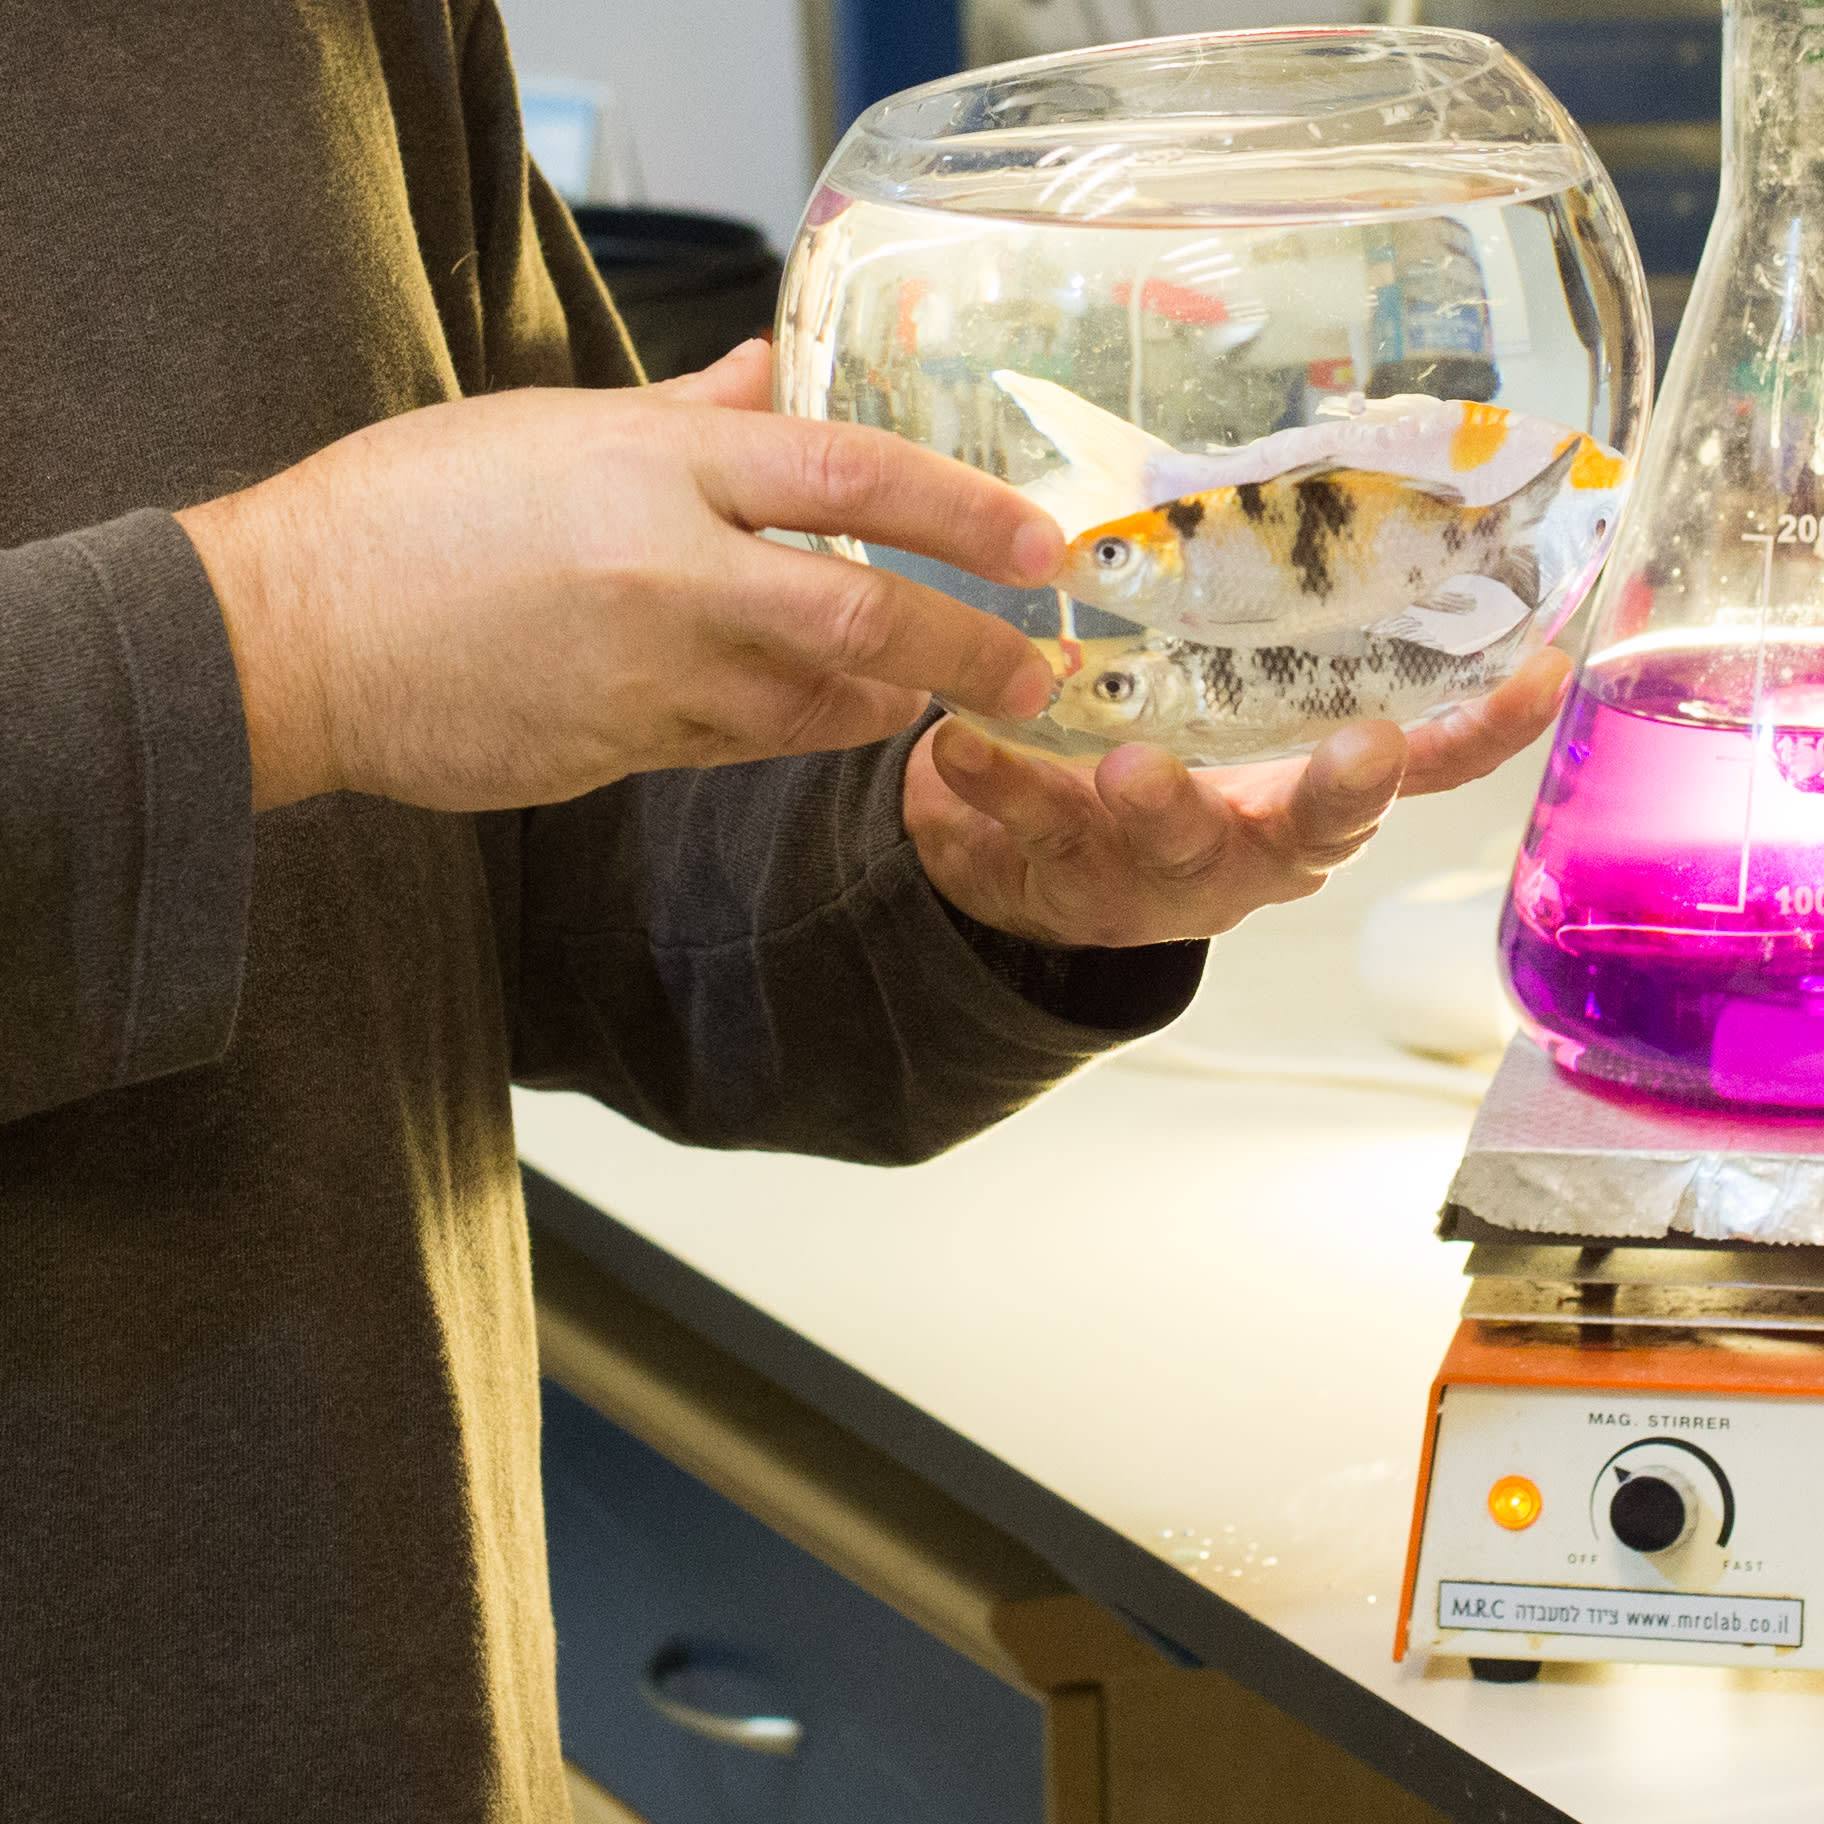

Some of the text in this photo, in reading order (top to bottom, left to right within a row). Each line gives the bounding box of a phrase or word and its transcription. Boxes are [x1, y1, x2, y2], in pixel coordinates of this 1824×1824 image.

[1588, 1412, 1732, 1431] MAG. STIRRER
[1567, 1552, 1600, 1567] OFF
[1722, 1559, 1765, 1574] FAST
[1625, 1608, 1790, 1636] www.mrclab.co.il
